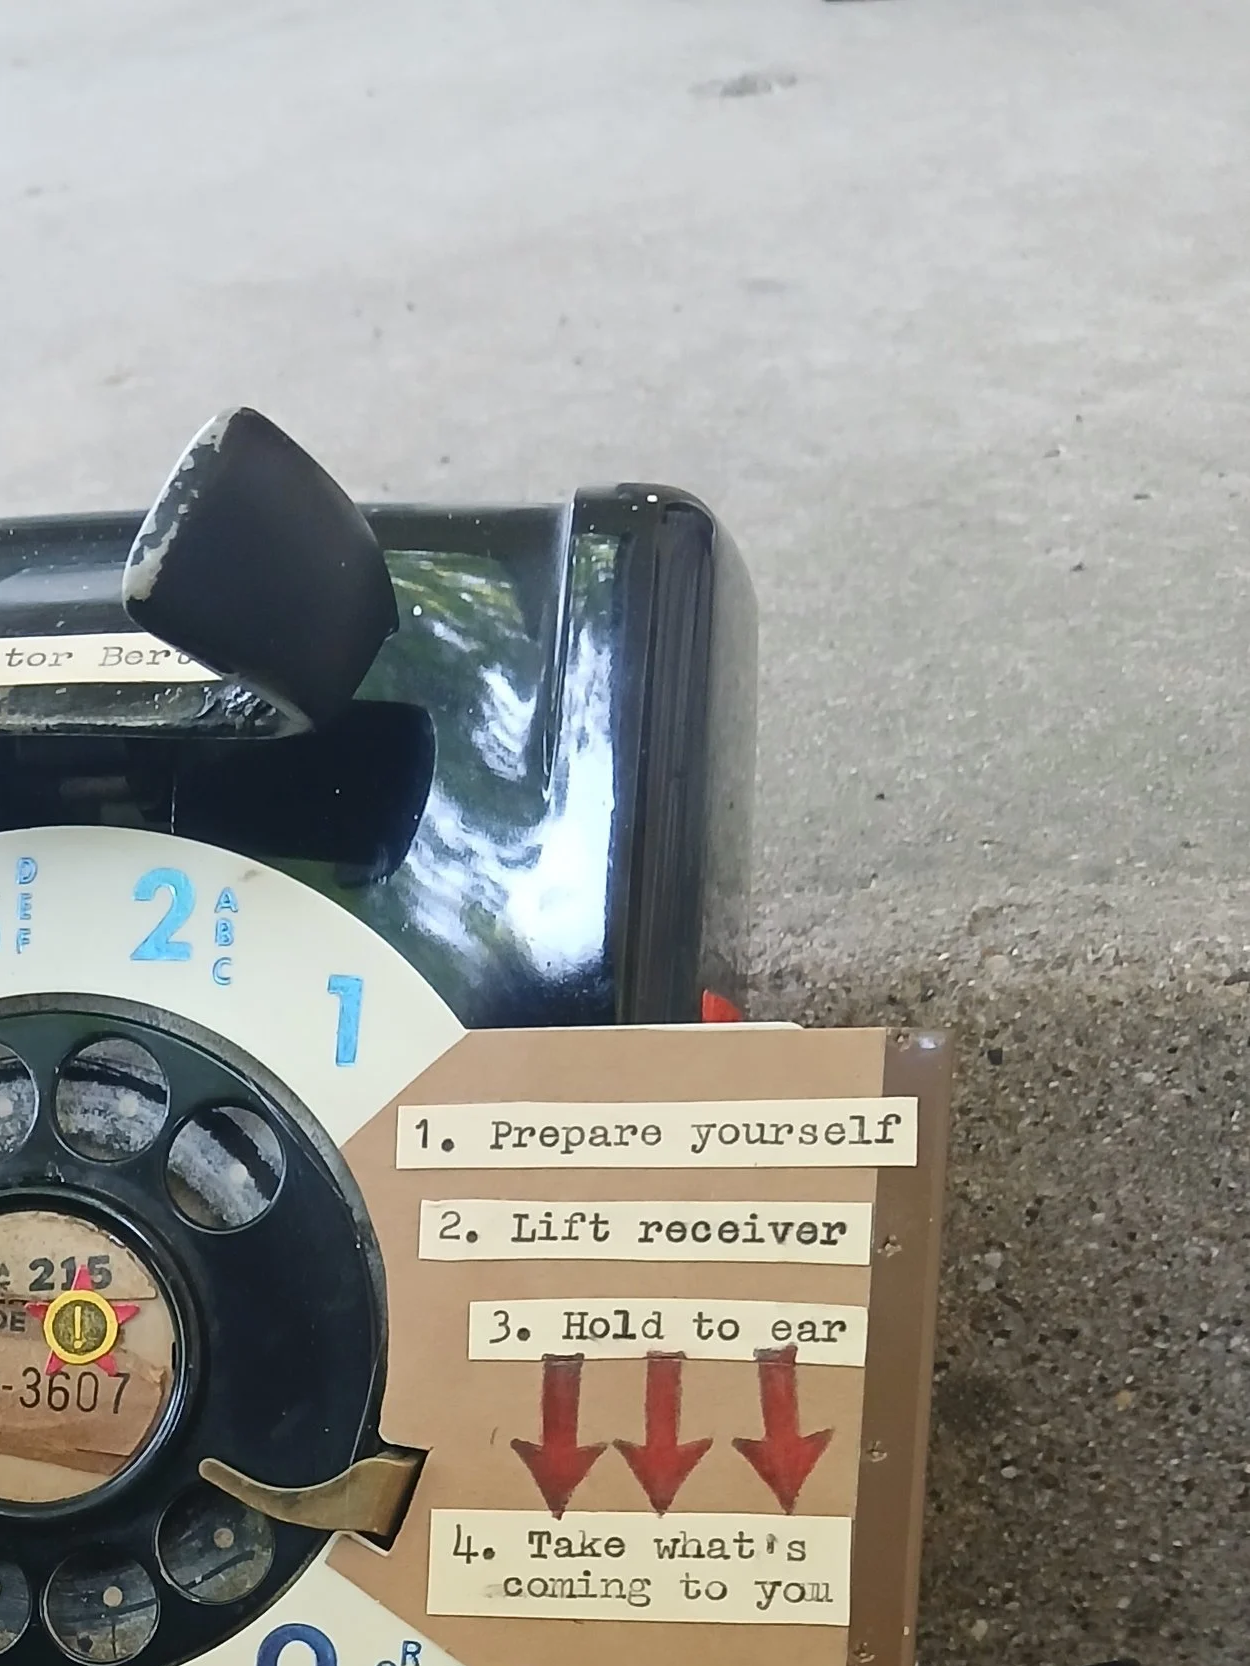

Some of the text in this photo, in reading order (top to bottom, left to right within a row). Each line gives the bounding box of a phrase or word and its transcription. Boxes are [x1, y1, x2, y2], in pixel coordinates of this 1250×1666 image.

[130, 867, 196, 961] 2
[327, 974, 364, 1067] 1
[414, 1114, 902, 1154] 1. Prepare yourself
[439, 1211, 848, 1245] 2. Lift receiver
[28, 1255, 112, 1291] 215
[489, 1310, 847, 1344] 3. Hold to ear
[452, 1524, 806, 1564] 4. Take what's
[503, 1569, 833, 1610] coming to you
